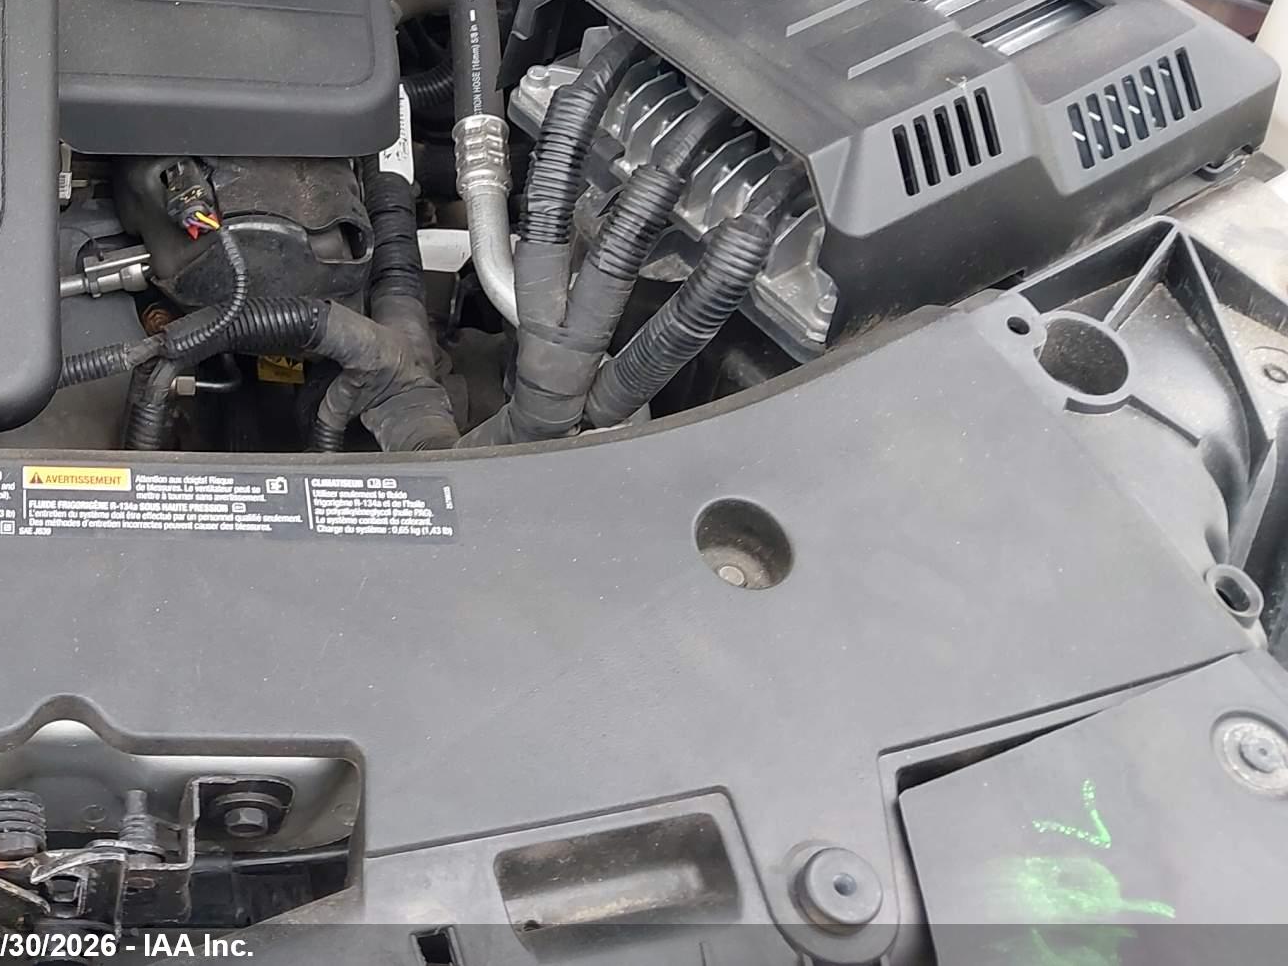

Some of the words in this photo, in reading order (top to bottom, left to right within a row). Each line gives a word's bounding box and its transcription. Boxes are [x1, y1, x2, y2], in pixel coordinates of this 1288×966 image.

[472, 71, 482, 93] HOSE
[46, 475, 121, 485] AVERTISSEMENT
[1, 482, 16, 490] and
[29, 500, 56, 509] FLUIDE
[139, 502, 160, 511] SOUS
[161, 503, 188, 512] HAUTE
[188, 504, 228, 512] PRESSION
